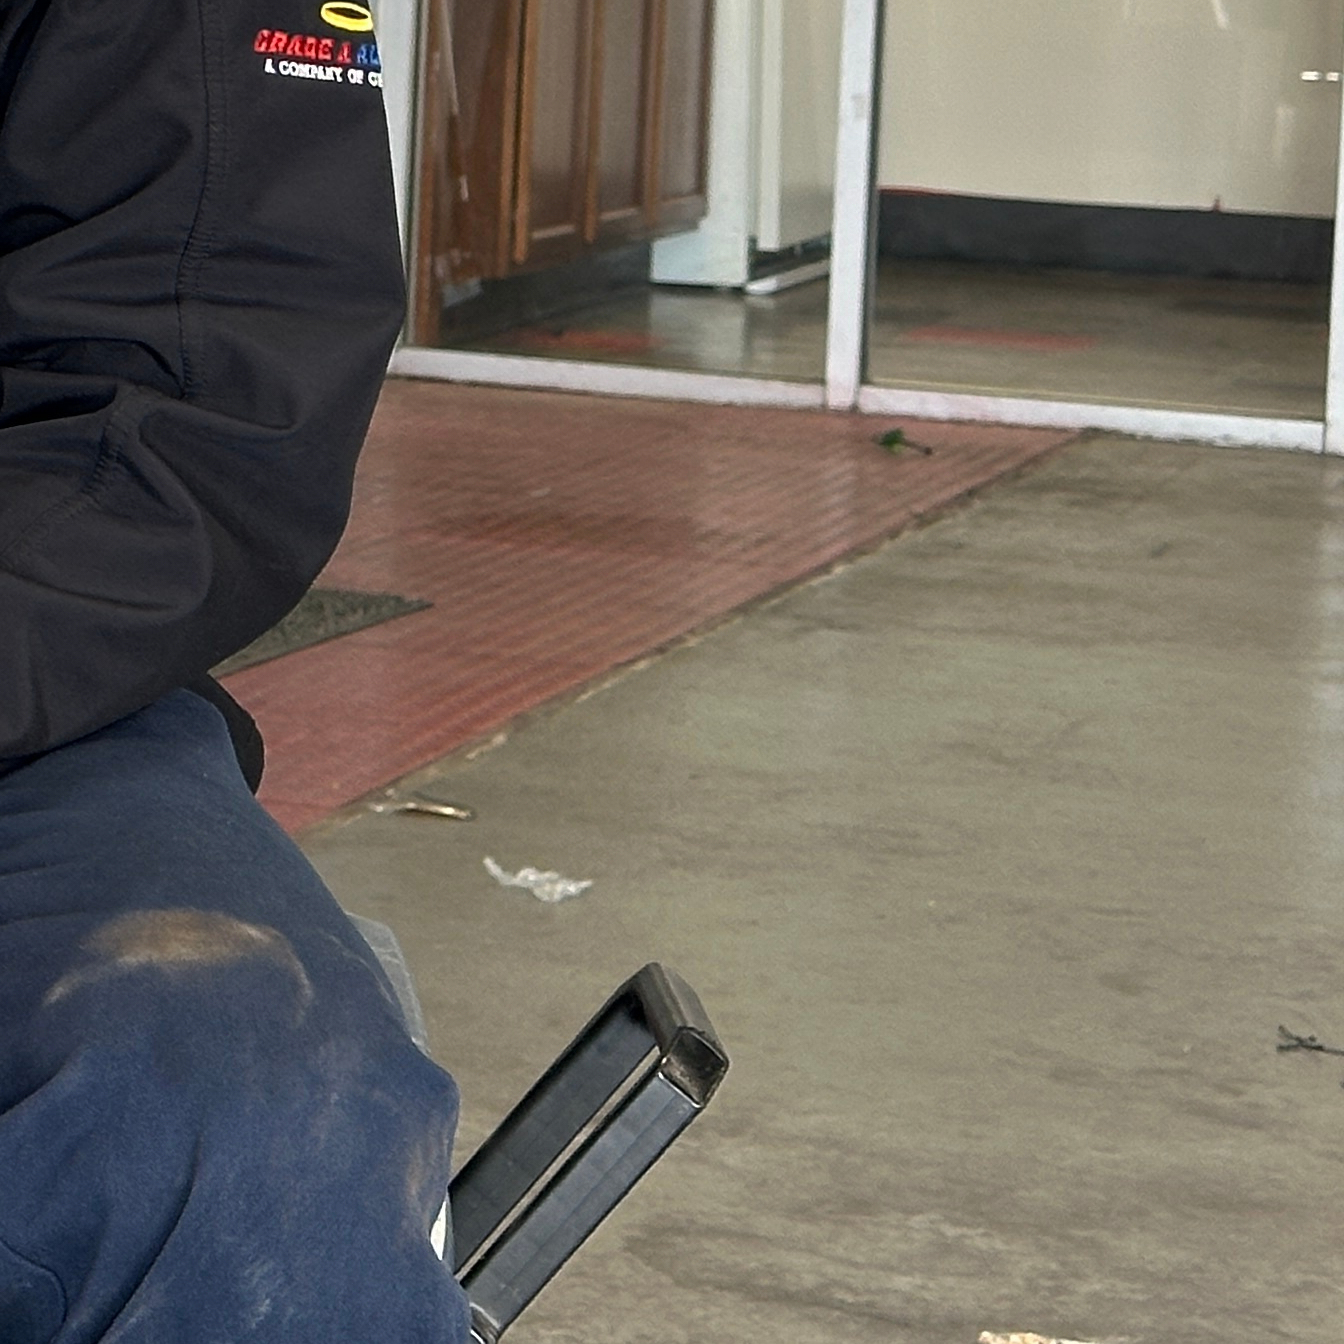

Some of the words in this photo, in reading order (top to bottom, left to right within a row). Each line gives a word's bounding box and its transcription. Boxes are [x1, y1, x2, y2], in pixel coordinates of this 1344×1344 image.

[254, 29, 334, 61] GRADE
[264, 58, 276, 74] A
[279, 60, 343, 83] COMPANY
